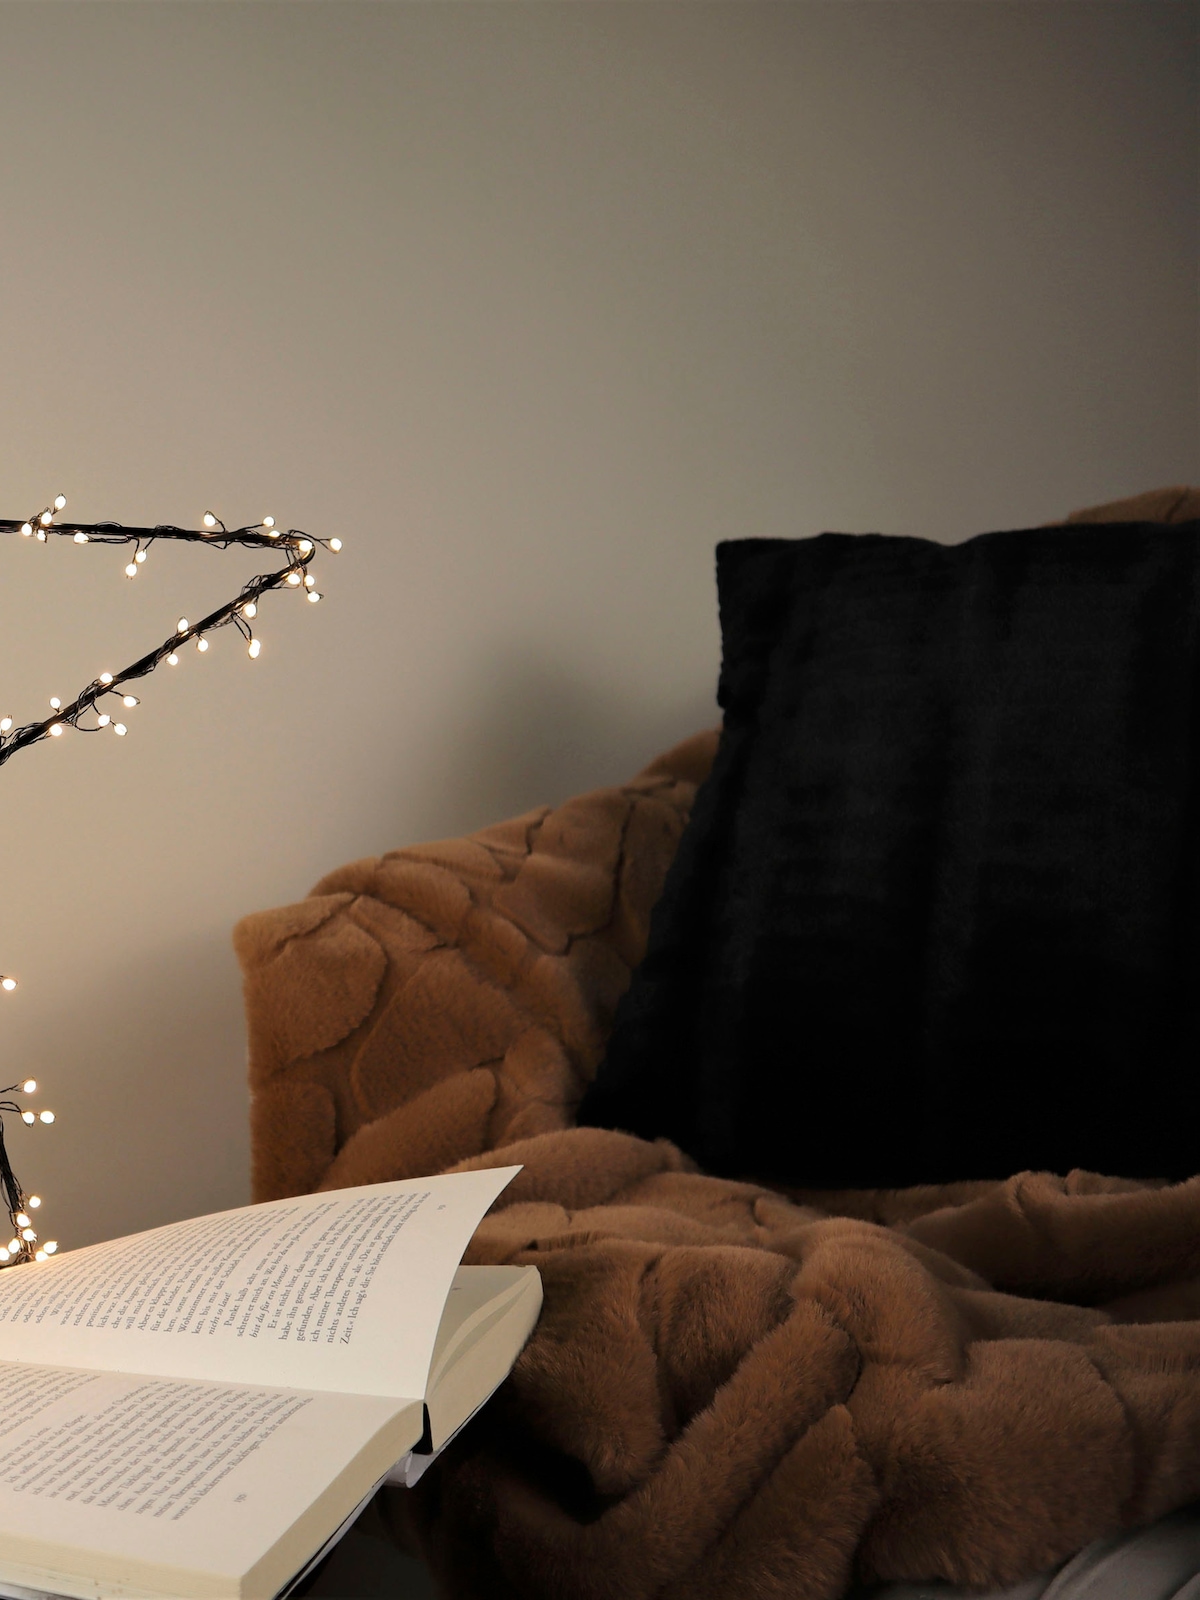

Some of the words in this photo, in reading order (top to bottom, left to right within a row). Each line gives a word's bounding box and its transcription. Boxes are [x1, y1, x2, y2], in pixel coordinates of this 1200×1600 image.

[177, 1268, 194, 1283] Punkt
[319, 1274, 328, 1282] ich
[323, 1258, 337, 1271] kann
[96, 1316, 109, 1328] lich
[106, 1302, 118, 1313] war.
[114, 1273, 140, 1299] Manchmal
[111, 1317, 122, 1328] che
[118, 1306, 128, 1315] die
[124, 1286, 141, 1304] Augen
[138, 1272, 153, 1285] gleich
[126, 1317, 136, 1329] will
[134, 1299, 146, 1314] mich
[144, 1278, 161, 1296] einfach
[162, 1285, 182, 1306] Kinder.
[176, 1297, 188, 1312] sonst
[186, 1274, 203, 1293] werden
[178, 1288, 206, 1332] Wohnzimmer
[204, 1277, 214, 1286] wie
[199, 1306, 211, 1315] bis
[209, 1292, 218, 1303] mir
[214, 1280, 225, 1290] der
[221, 1260, 240, 1278] Schädel
[224, 1305, 240, 1326] Punkt
[235, 1288, 248, 1302] halb
[247, 1274, 258, 1285] acht
[237, 1313, 251, 1336] schreit
[252, 1287, 263, 1303] mich
[264, 1266, 276, 1274] Was
[260, 1301, 270, 1313] für
[268, 1320, 277, 1328] Er
[279, 1290, 291, 1306] nicht
[294, 1264, 305, 1272] das
[278, 1322, 292, 1340] habe
[287, 1307, 298, 1318] ihn
[296, 1280, 310, 1304] getötet.
[305, 1269, 317, 1277] Ich
[310, 1285, 322, 1301] Aber
[311, 1330, 320, 1342] ich
[317, 1301, 330, 1326] meiner
[324, 1262, 350, 1298] Therapeutin
[348, 1307, 359, 1318] Ich
[365, 1266, 376, 1276] Sie
[138, 1314, 150, 1330] Aber
[149, 1287, 167, 1304] klappt
[150, 1321, 161, 1331] für
[157, 1308, 168, 1318] die
[209, 1317, 220, 1334] nicht
[256, 1314, 265, 1323] du
[296, 1304, 314, 1341] gefunden.
[328, 1319, 339, 1343] nichts
[336, 1290, 350, 1316] anderes
[249, 1324, 260, 1337] bist
